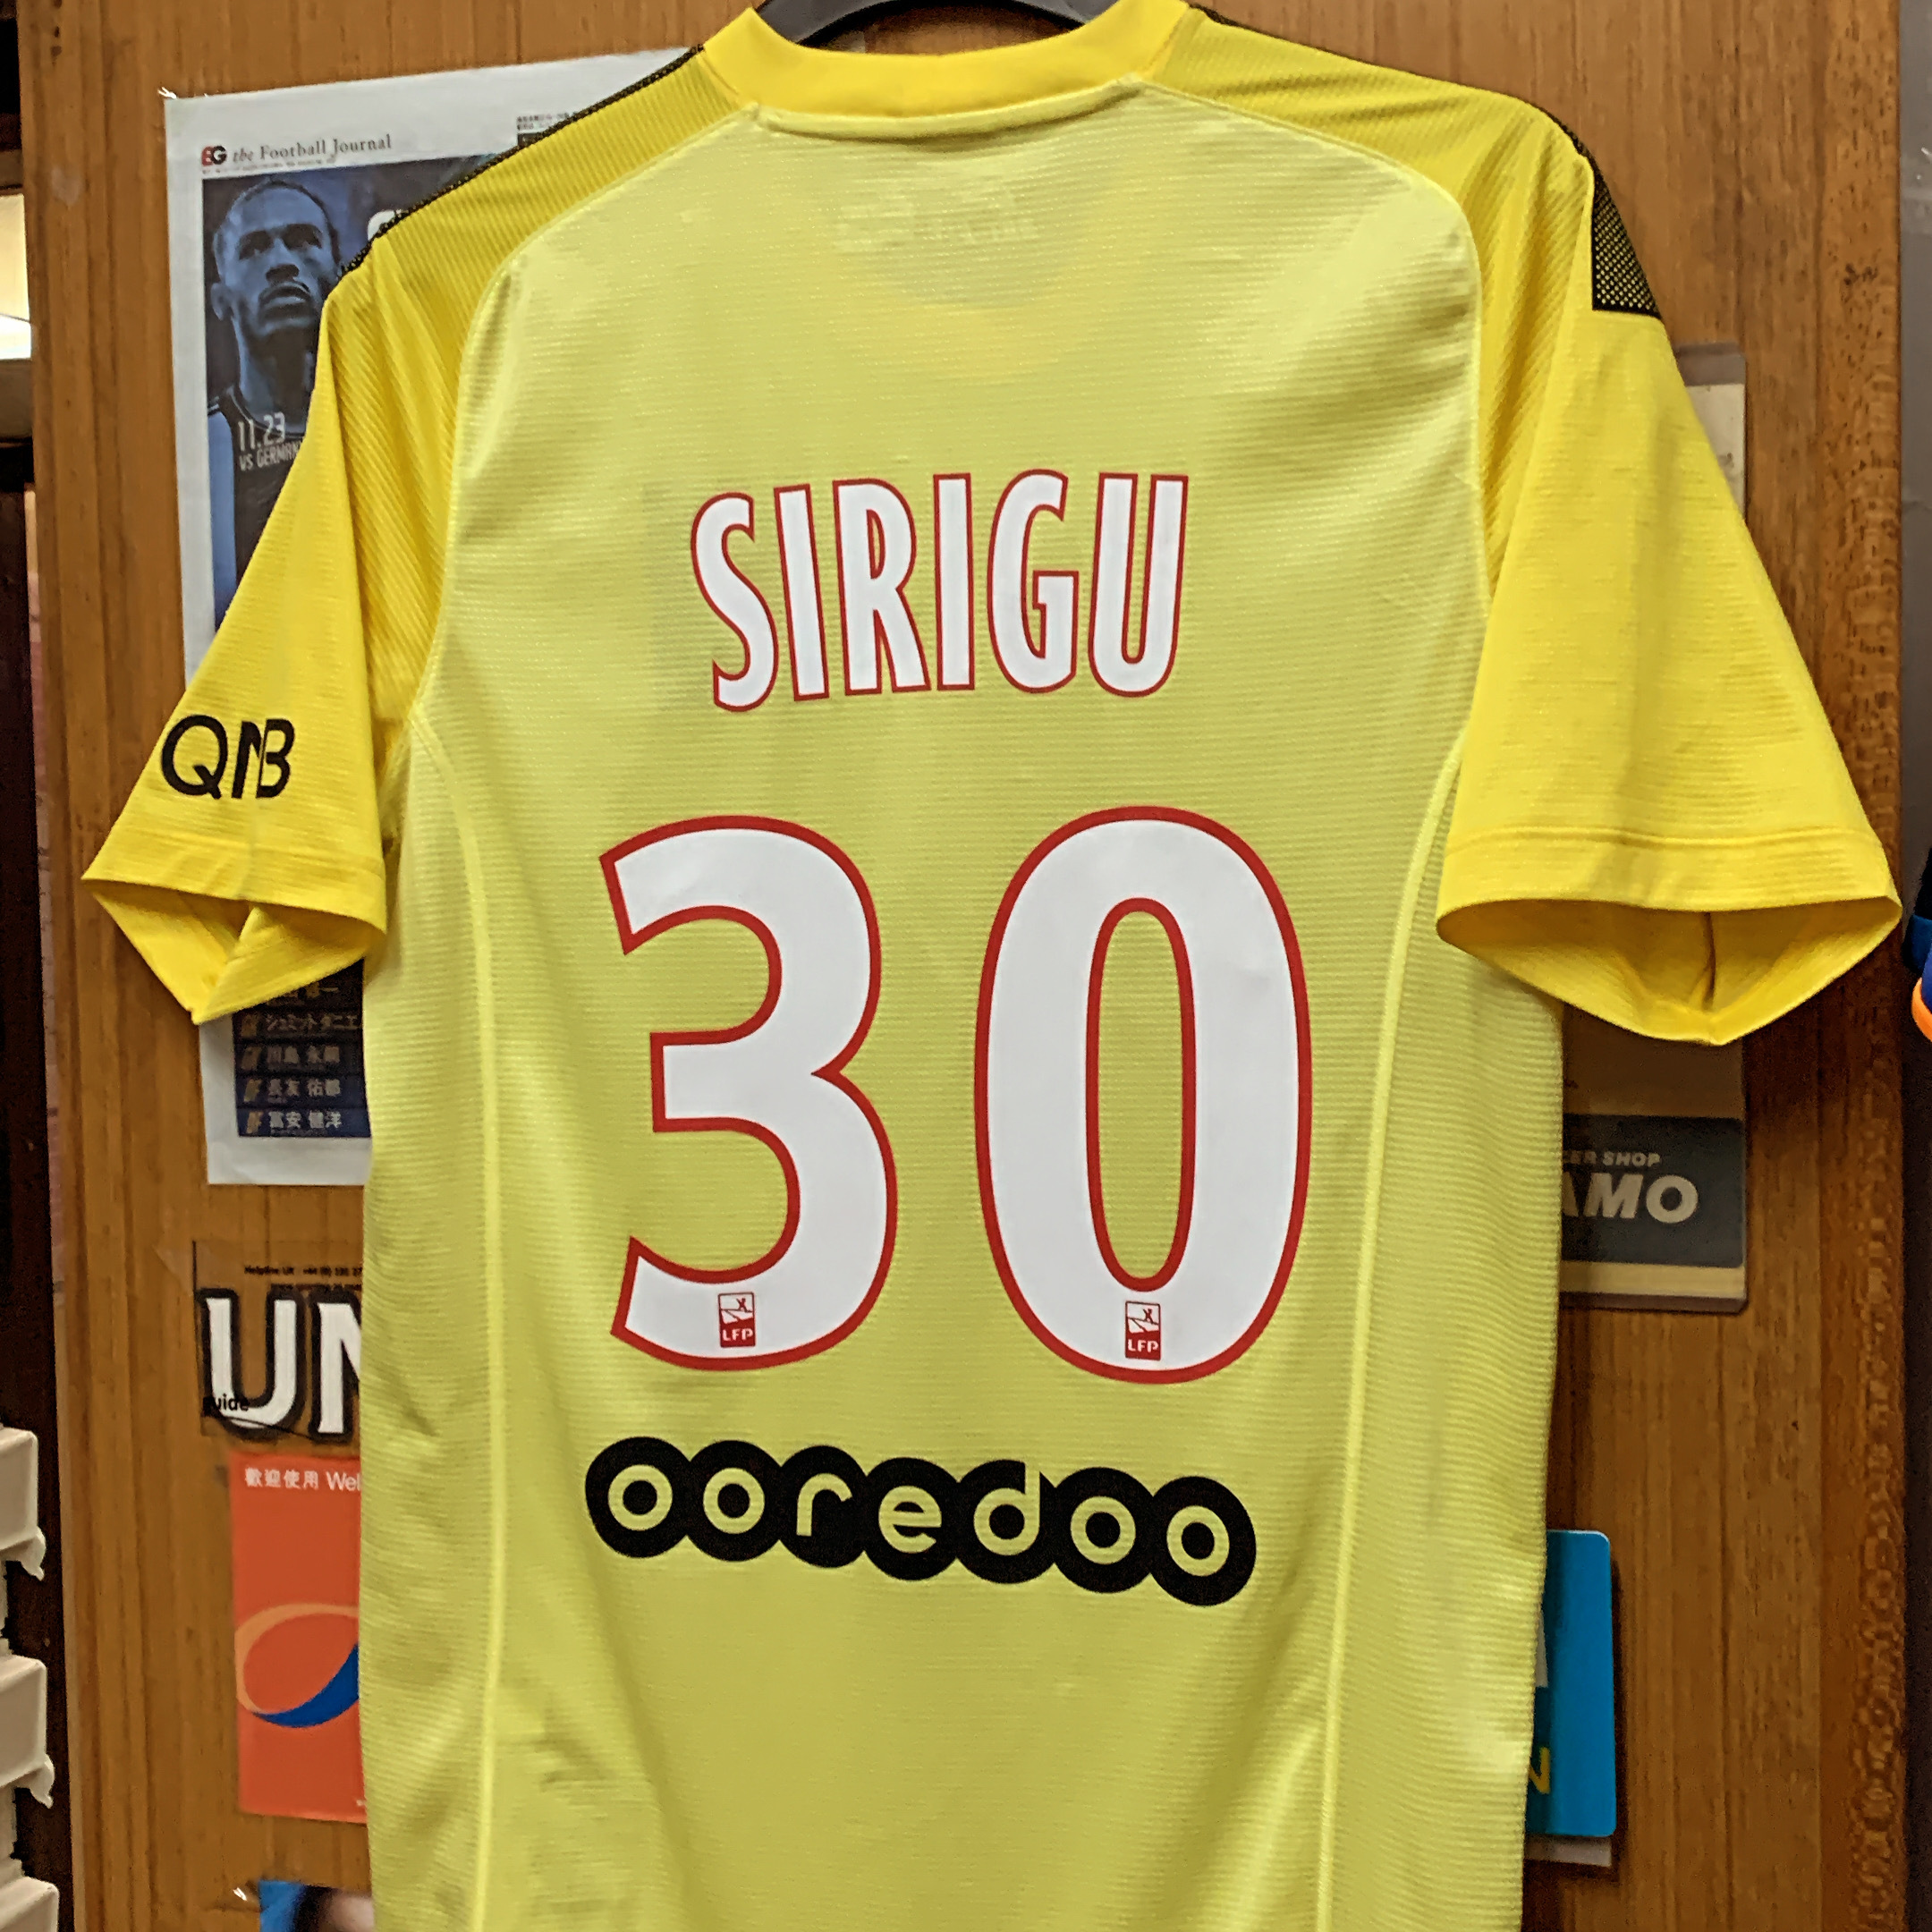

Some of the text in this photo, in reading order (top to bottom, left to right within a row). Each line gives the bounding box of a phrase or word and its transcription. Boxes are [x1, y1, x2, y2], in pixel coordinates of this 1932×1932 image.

[233, 147, 254, 163] the
[259, 140, 326, 160] Football
[333, 133, 392, 156] Journal
[238, 412, 285, 452] 11.23
[239, 453, 254, 471] VS
[691, 469, 1189, 712] SIRIGU
[161, 715, 295, 800] QNB
[600, 806, 1313, 1385] 30
[1603, 1150, 1661, 1167] SHOP
[722, 1328, 754, 1342] LFP
[1127, 1338, 1159, 1353] LFP
[603, 1456, 1235, 1583] ooredoo
